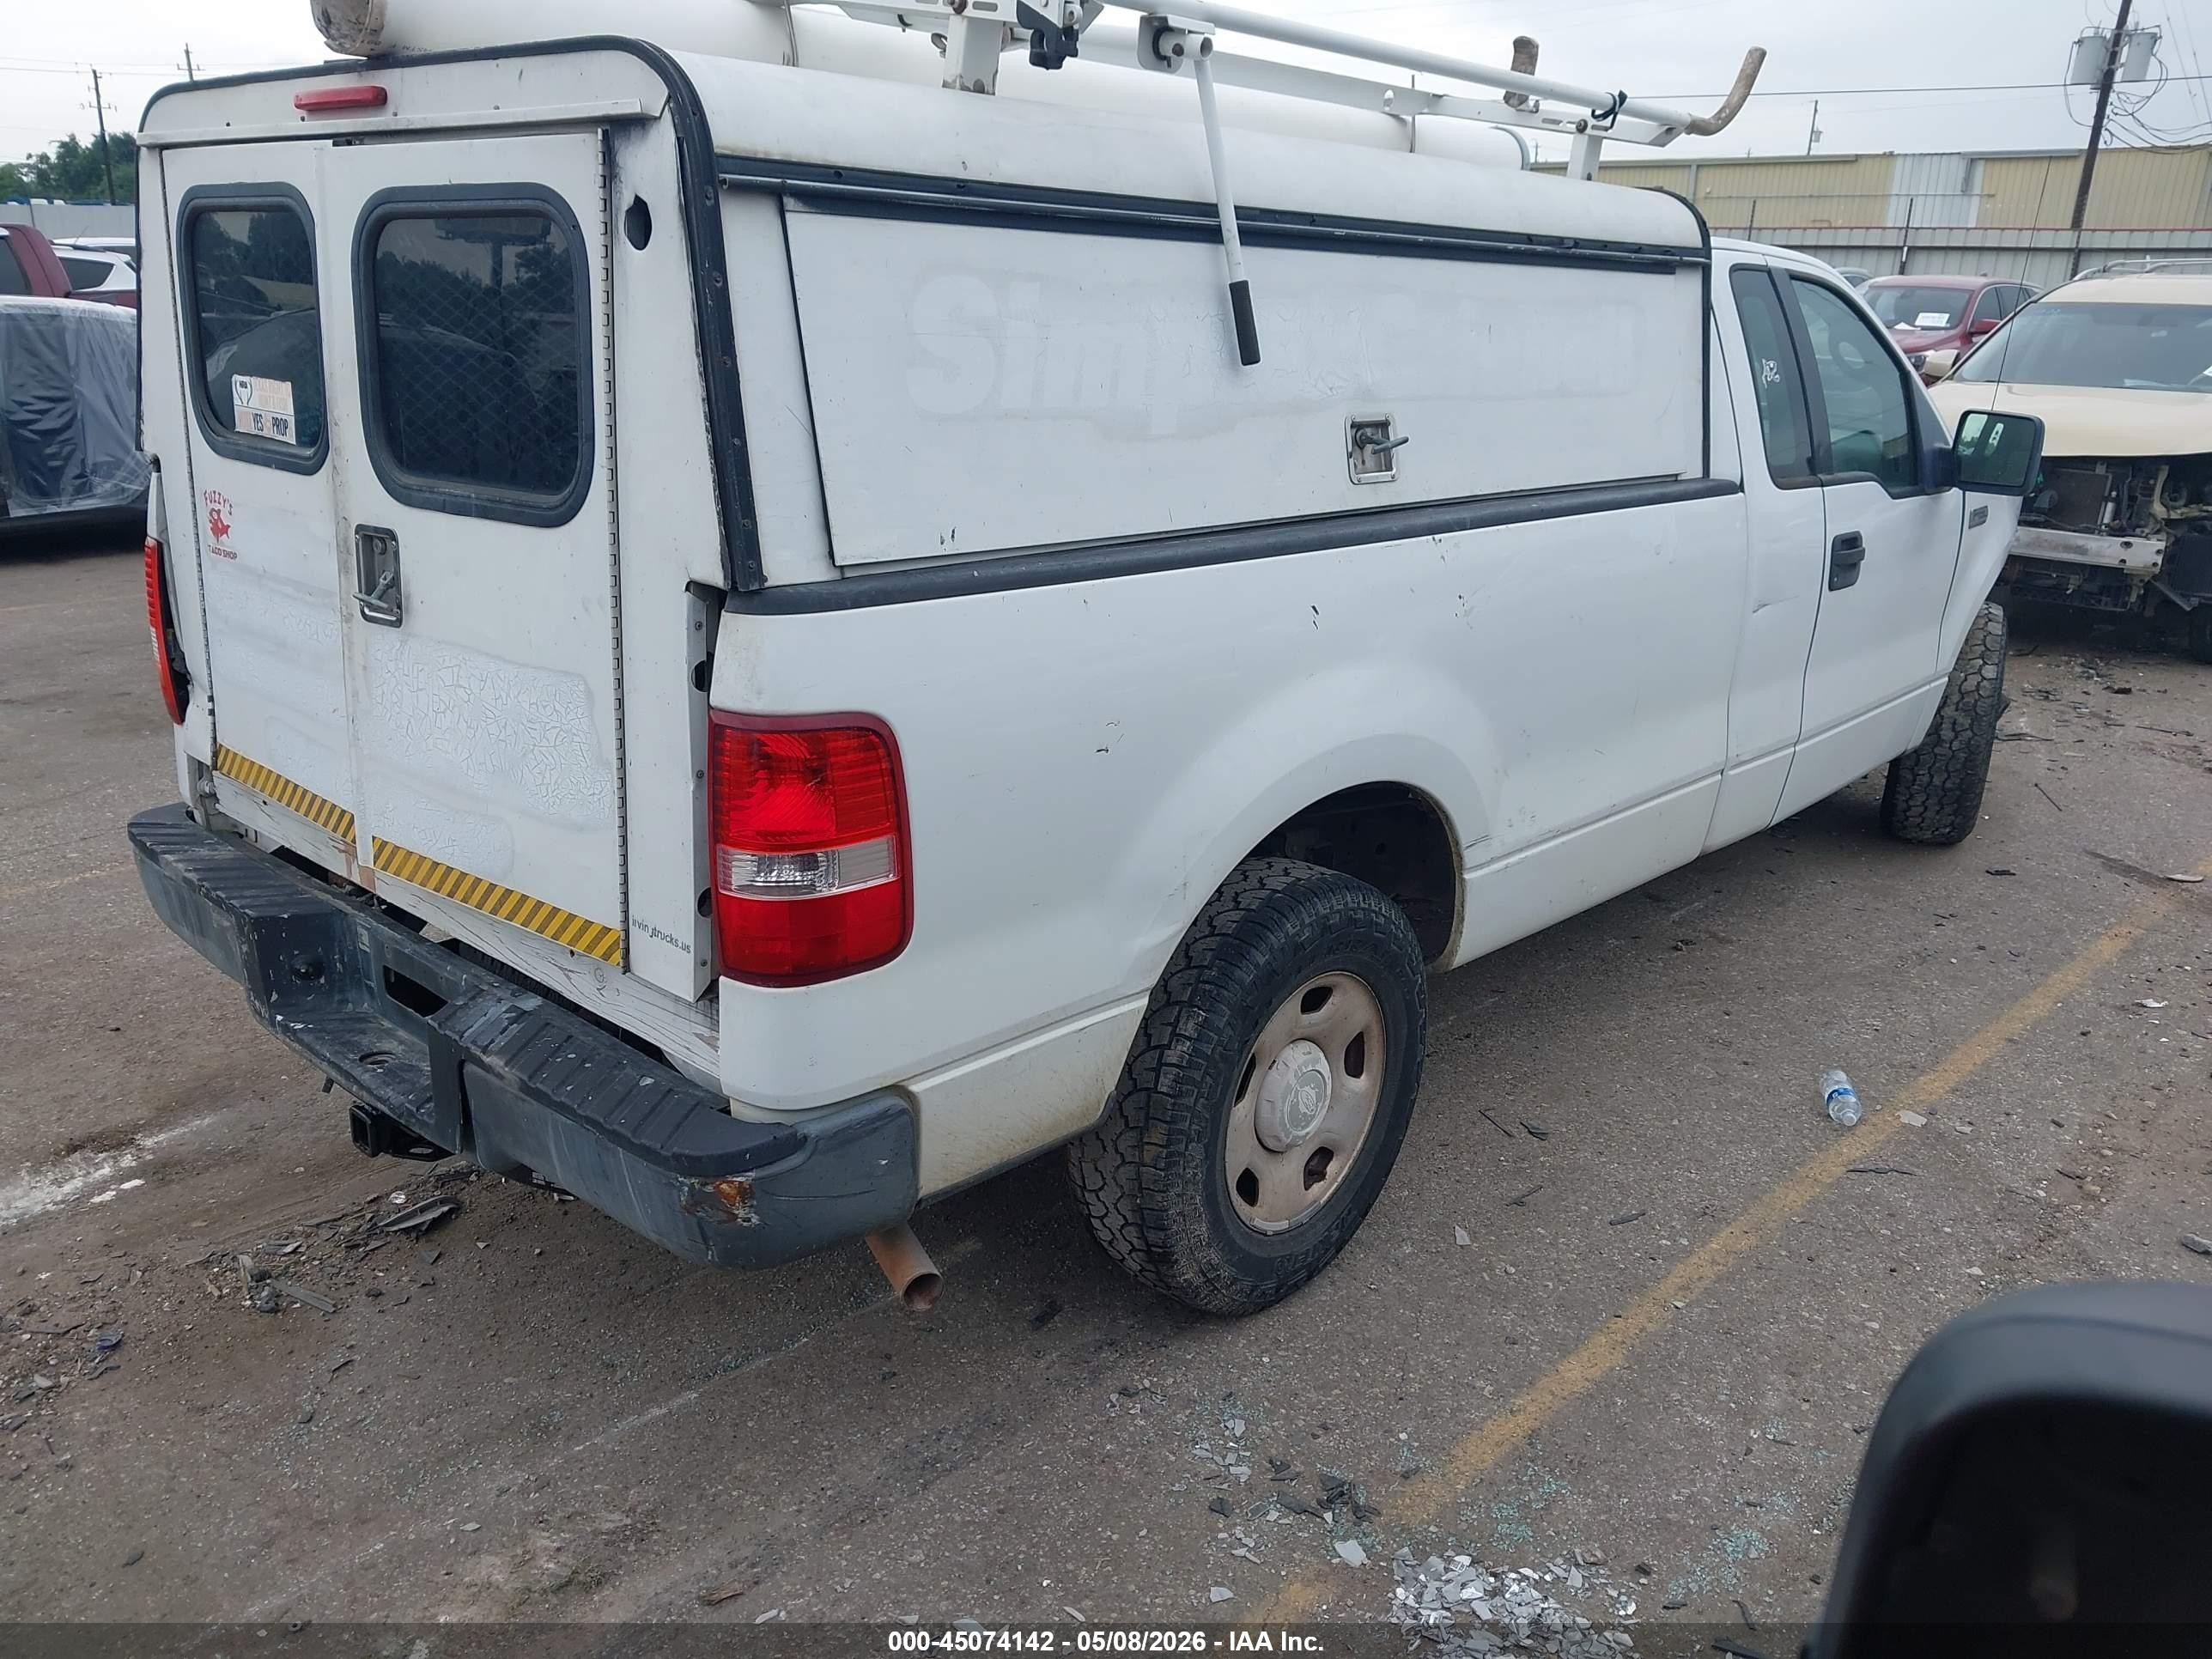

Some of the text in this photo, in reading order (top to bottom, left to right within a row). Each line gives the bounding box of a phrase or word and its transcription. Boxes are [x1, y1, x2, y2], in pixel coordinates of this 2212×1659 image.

[252, 412, 264, 432] YES
[271, 416, 289, 437] PROP
[204, 489, 234, 515] FUZZY'S
[208, 544, 238, 561] TACO SHOP
